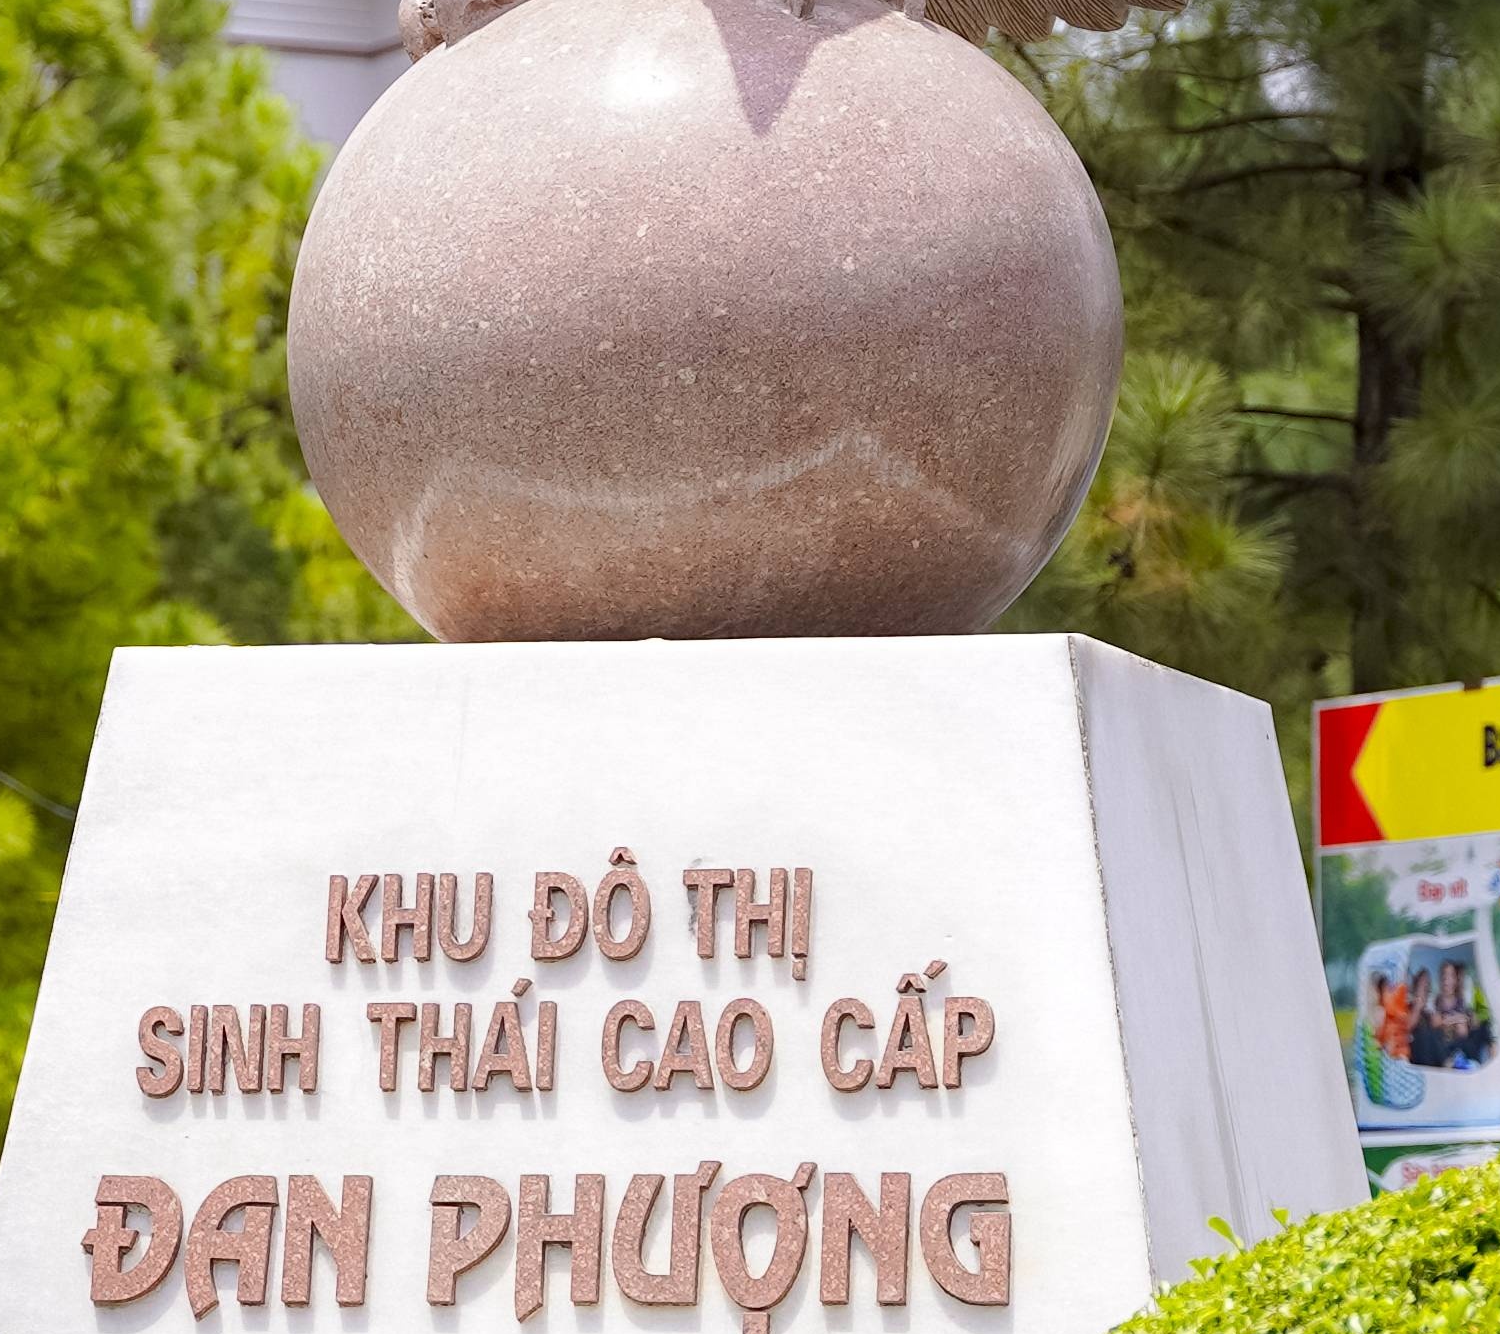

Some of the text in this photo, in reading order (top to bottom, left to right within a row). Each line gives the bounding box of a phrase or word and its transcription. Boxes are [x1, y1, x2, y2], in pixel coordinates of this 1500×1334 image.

[325, 846, 813, 981] KHU ĐÔ THỊ
[136, 960, 995, 1098] SINH THÁI CAO CẤP
[81, 1173, 373, 1321] ĐAN
